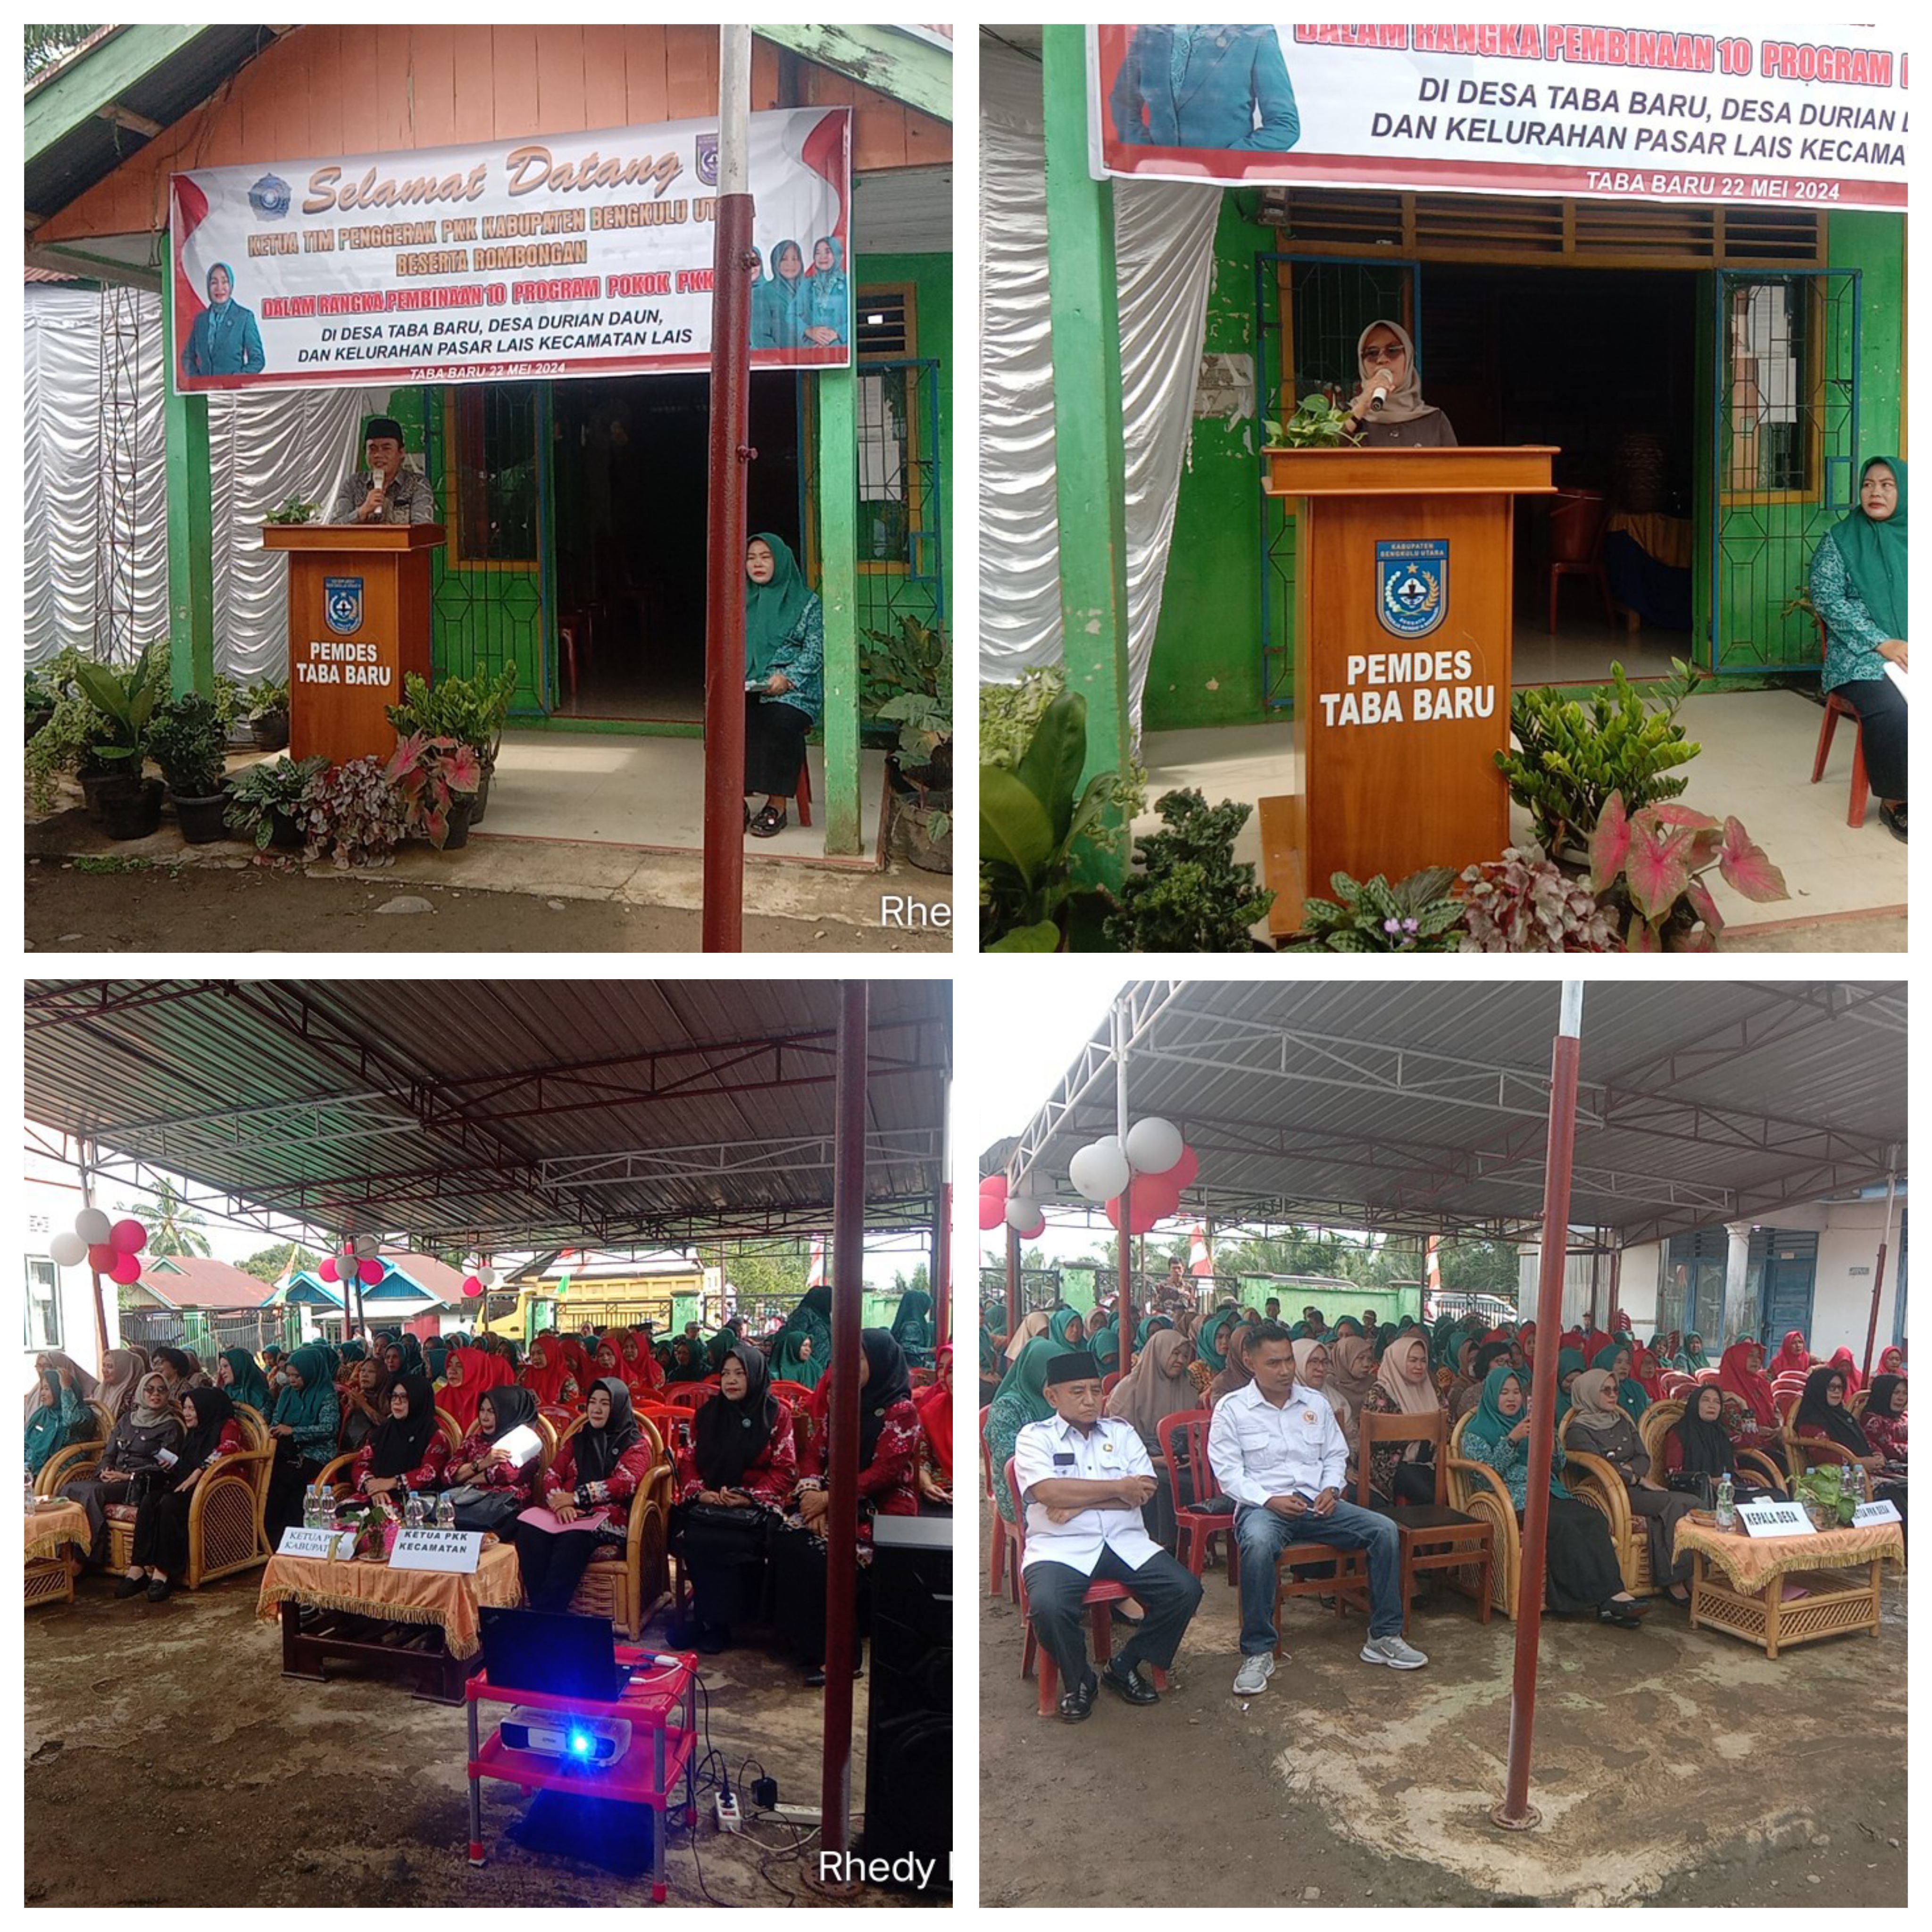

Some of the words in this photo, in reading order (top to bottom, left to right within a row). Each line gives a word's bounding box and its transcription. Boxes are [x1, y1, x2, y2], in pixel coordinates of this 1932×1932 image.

[1412, 24, 1542, 60] RANGKA
[1546, 24, 1714, 72] PEMBINAAN
[1717, 38, 1752, 75] 10
[1761, 41, 1892, 87] PROGRAM
[1418, 77, 1449, 102] DI
[1457, 80, 1537, 108] DESA
[1548, 85, 1619, 113] TABA
[1628, 92, 1711, 122] BARU,
[1721, 98, 1792, 124] DESA
[1799, 104, 1896, 131] DURIAN
[1371, 113, 1437, 140] DAN
[1446, 117, 1627, 150] KELURAHAN
[1634, 128, 1727, 155] PASAR
[1734, 134, 1792, 158] LAIS
[1800, 138, 1908, 166] KECAMA
[303, 162, 488, 216] Selamat
[506, 145, 683, 198] Datang
[1587, 171, 1645, 192] TABA
[1651, 175, 1715, 195] BARU
[1721, 178, 1744, 196] 22
[1750, 179, 1790, 198] MEI
[1794, 181, 1840, 200] 2024
[248, 233, 299, 257] KETUA
[304, 230, 333, 253] TIM
[339, 221, 437, 251] PENGGERAK
[441, 218, 477, 243] PKK
[482, 208, 585, 238] KABUPATEN
[591, 199, 687, 231] BENGKULU
[396, 250, 468, 276] BESERTA
[474, 240, 587, 270] ROMBONGAN
[262, 294, 315, 319] DALAM
[319, 291, 384, 316] RANGKA
[386, 285, 482, 313] PEMBINAAN
[484, 283, 507, 305] 10
[513, 277, 600, 304] PROGRAM
[607, 272, 670, 297] POKOK
[676, 269, 714, 293] PKK
[322, 328, 336, 341] DI
[341, 326, 383, 341] DESA
[388, 323, 429, 338] TABA
[433, 320, 483, 336] BARU,
[489, 317, 533, 333] DESA
[538, 314, 604, 330] DURIAN
[608, 310, 663, 326] DAUN,
[298, 349, 330, 363] DAN
[334, 343, 433, 360] KELURAHAN
[437, 340, 492, 356] PASAR
[497, 337, 533, 352] LAIS
[538, 332, 646, 350] KECAMATAN
[651, 329, 692, 344] LAIS
[409, 368, 444, 380] TABA
[448, 366, 485, 379] BARU
[490, 366, 504, 377] 22
[507, 364, 531, 376] MEI
[534, 363, 565, 374] 2024
[310, 642, 377, 662] PEMDES
[1348, 650, 1472, 685] PEMDES
[296, 663, 340, 684] TABA
[345, 665, 391, 686] BARU
[1320, 690, 1404, 727] TABA
[1414, 685, 1494, 721] BARU
[1745, 1512, 1778, 1525] KEPALA
[290, 1532, 322, 1541] KETUA
[399, 1542, 467, 1553] KECAMATAN
[404, 1531, 440, 1539] KETUA
[445, 1532, 467, 1541] PKK
